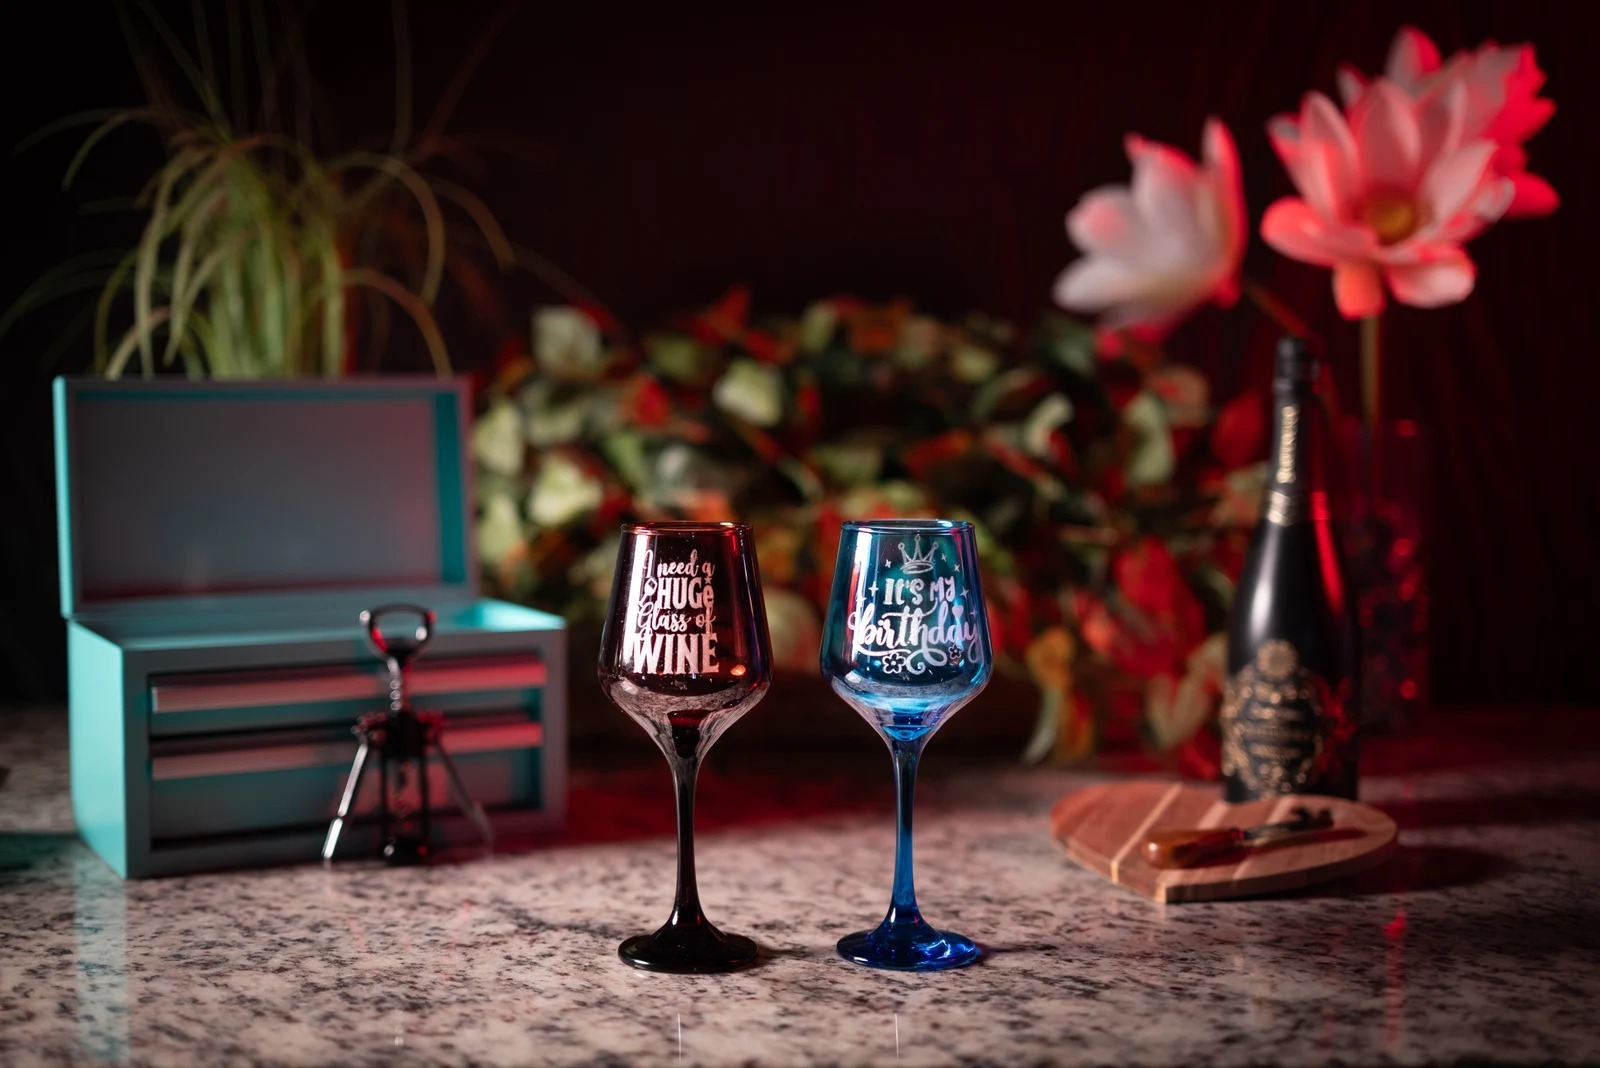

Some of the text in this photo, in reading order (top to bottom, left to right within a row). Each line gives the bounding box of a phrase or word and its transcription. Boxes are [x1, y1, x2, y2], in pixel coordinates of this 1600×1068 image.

[642, 549, 715, 578] I need a
[637, 601, 716, 640] Glass of
[847, 601, 984, 664] birthday
[632, 632, 720, 675] WINE
